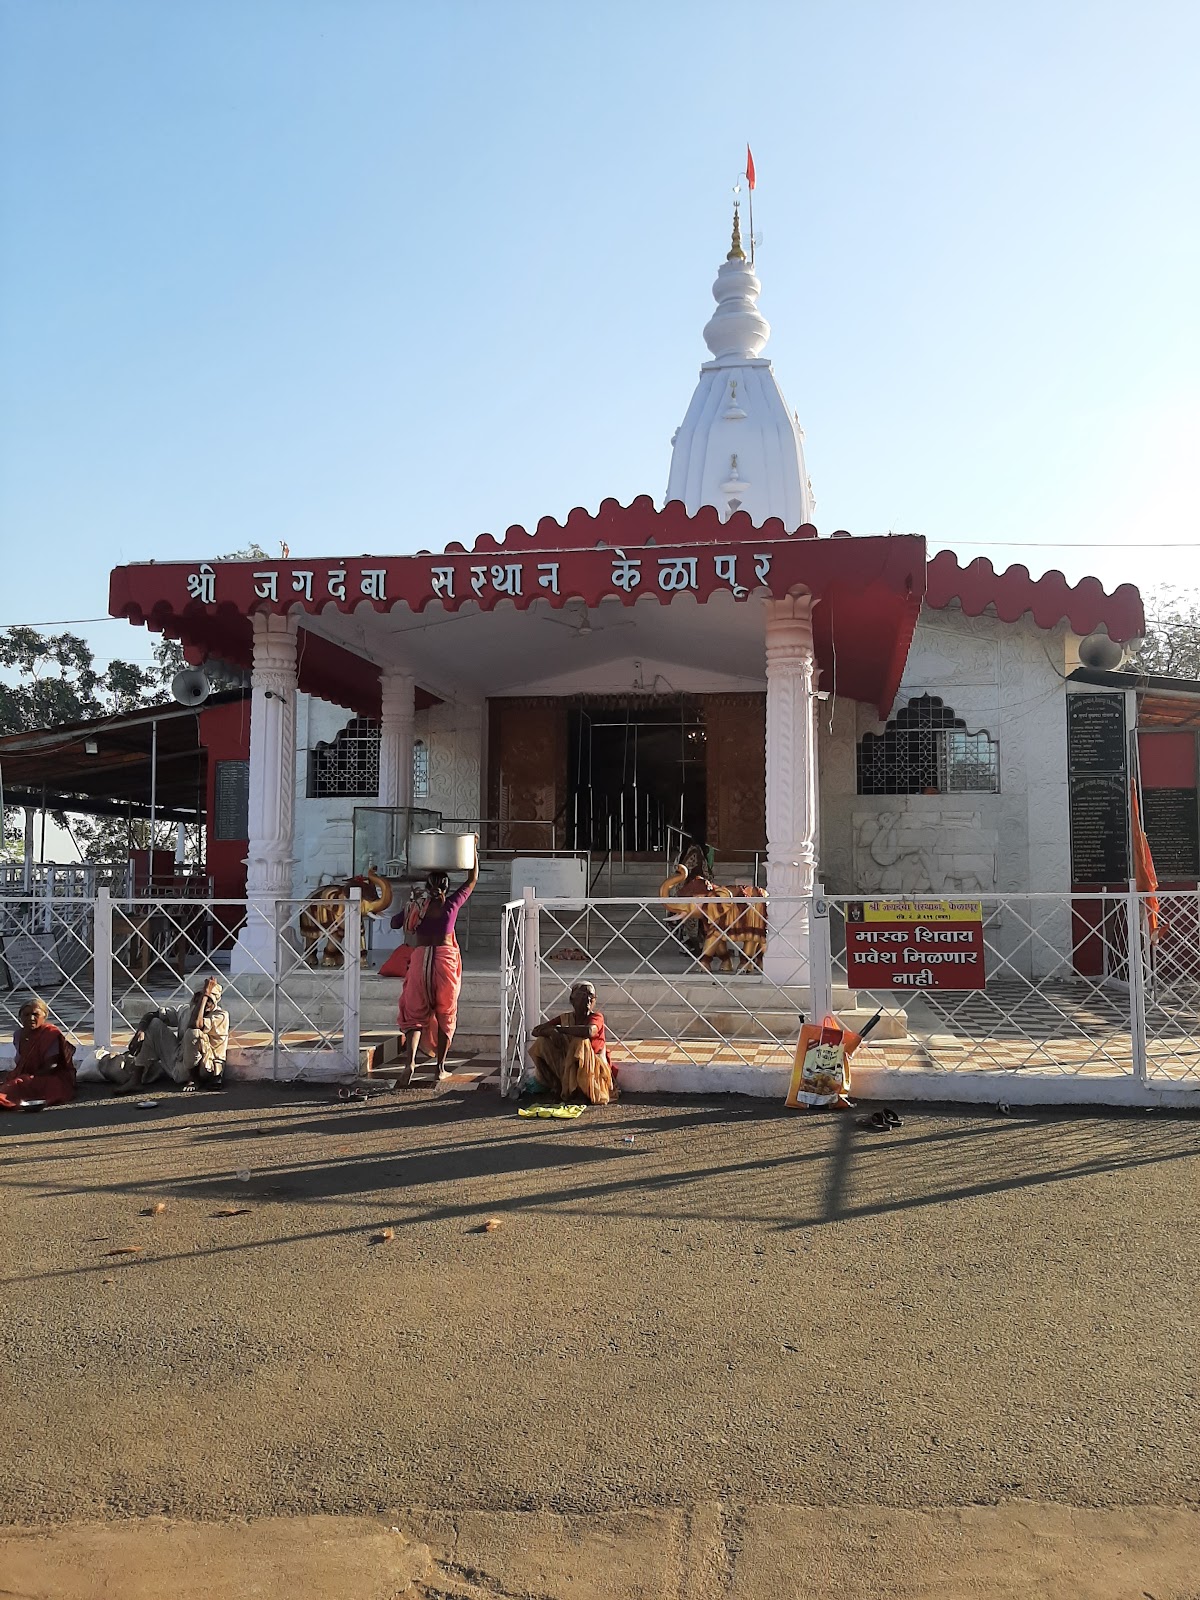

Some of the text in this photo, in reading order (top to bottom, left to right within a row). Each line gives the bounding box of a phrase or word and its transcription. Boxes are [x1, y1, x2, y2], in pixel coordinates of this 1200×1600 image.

[187, 564, 216, 604] श्री
[253, 561, 388, 601] जगदंबा
[611, 549, 773, 598] केळापूर
[855, 926, 974, 943] मास्क शिवाय
[853, 947, 978, 964] प्रवेश मिळणार
[892, 968, 939, 986] नाही.
